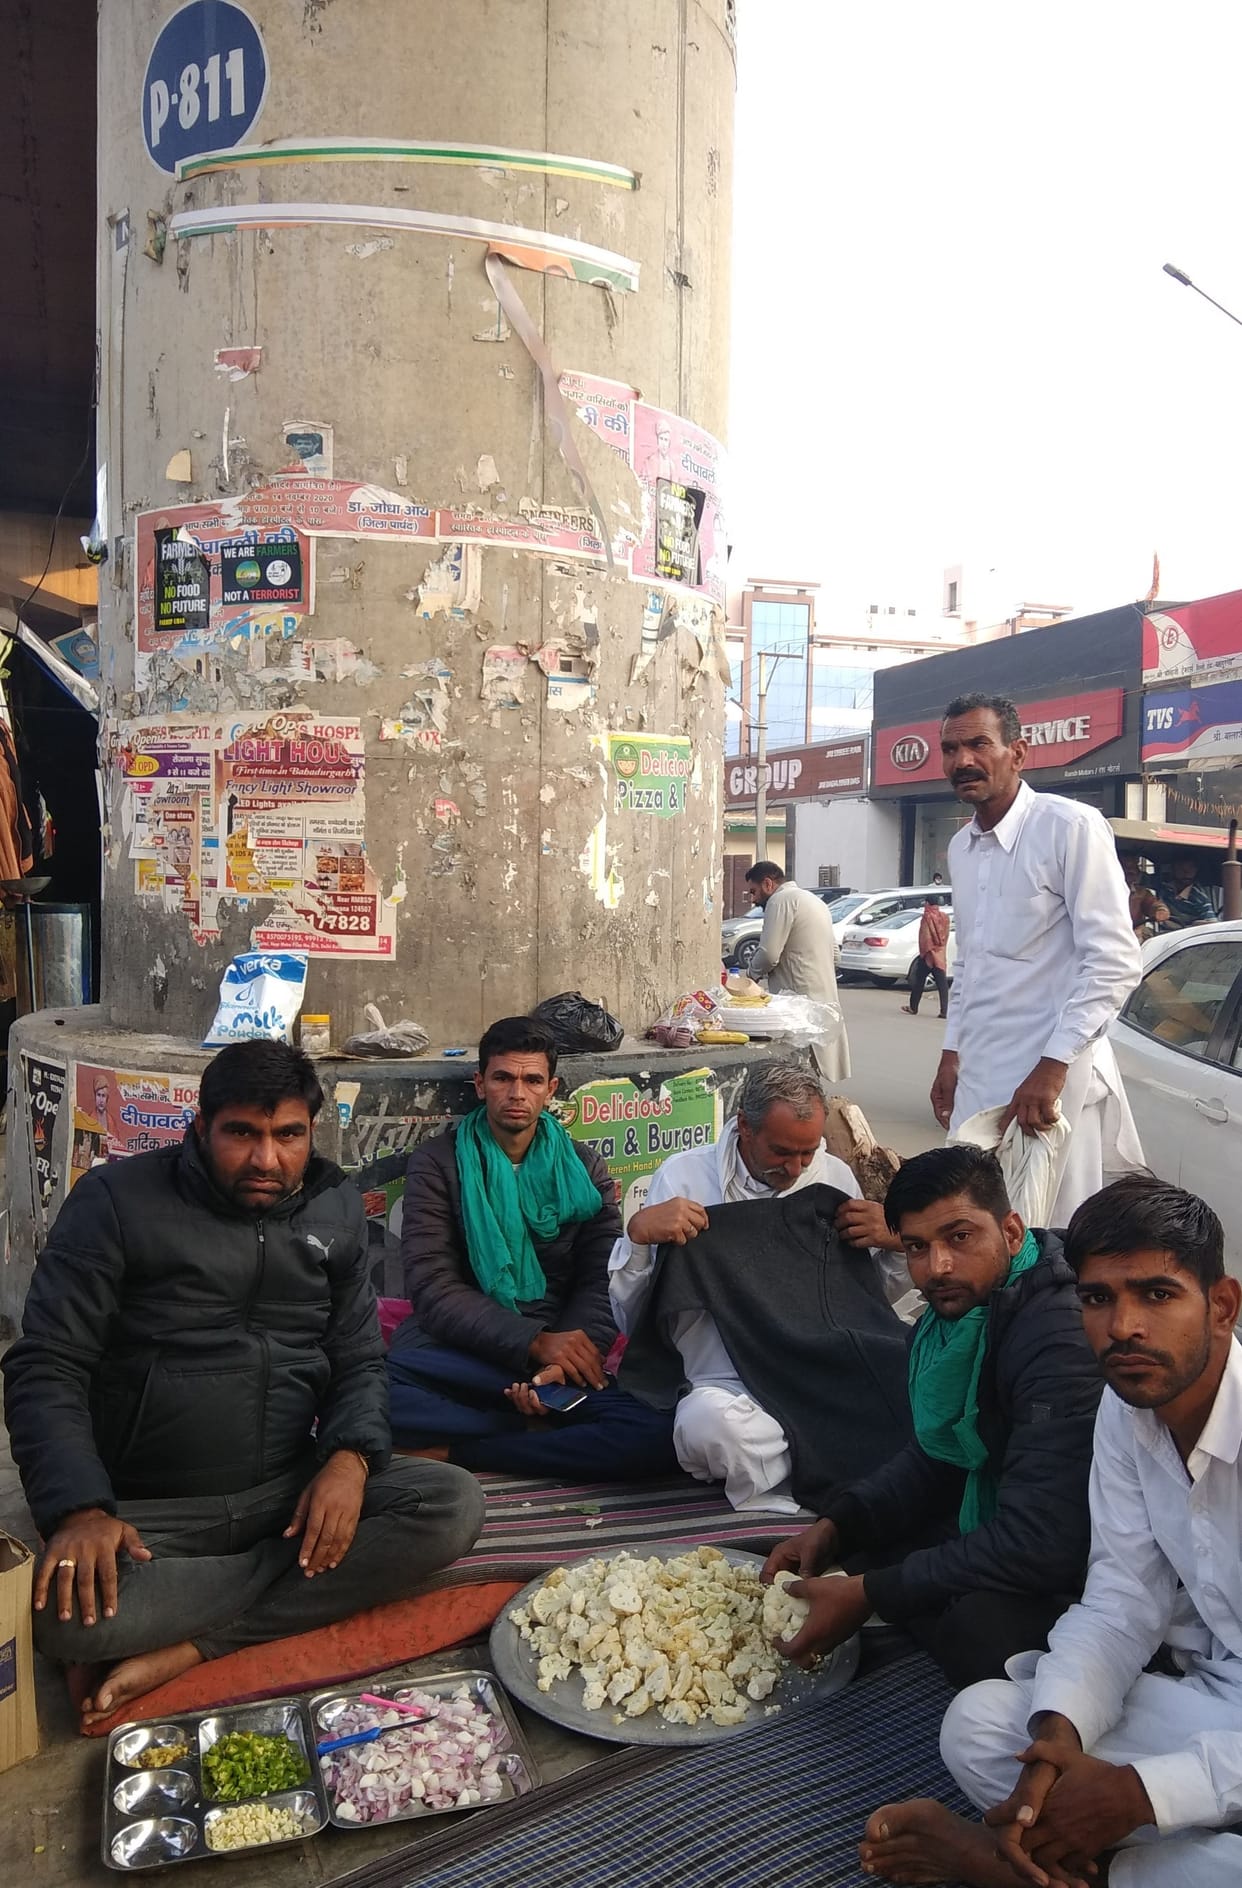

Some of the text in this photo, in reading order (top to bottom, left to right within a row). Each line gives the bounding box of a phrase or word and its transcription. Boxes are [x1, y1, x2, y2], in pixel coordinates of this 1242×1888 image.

[314, 495, 334, 503] 2020
[672, 483, 687, 498] NO
[223, 545, 298, 558] WE ARE FARMERS
[659, 547, 696, 570] NO FUTURE
[164, 586, 176, 599] NO
[177, 584, 200, 597] FOOD
[224, 588, 300, 602] NOT A TERRORIST
[161, 599, 207, 614] NO FUTURE
[1147, 706, 1173, 731] TVS
[1020, 715, 1091, 746] ERVICE
[224, 739, 285, 762] LIGHT
[895, 744, 922, 763] KIA
[138, 761, 153, 772] OPD
[236, 764, 257, 776] First
[730, 758, 803, 796] GROUP
[226, 780, 257, 795] Fancy
[261, 779, 292, 795] Light
[616, 780, 679, 811] Pizza &
[252, 800, 276, 809] Lights
[240, 956, 282, 975] verka
[233, 1005, 286, 1030] milk
[582, 1092, 673, 1124] Delicious
[127, 1132, 160, 1151] हार्दिक
[624, 1126, 641, 1156] &
[648, 1122, 711, 1152] Burger
[633, 1162, 653, 1171] Hand
